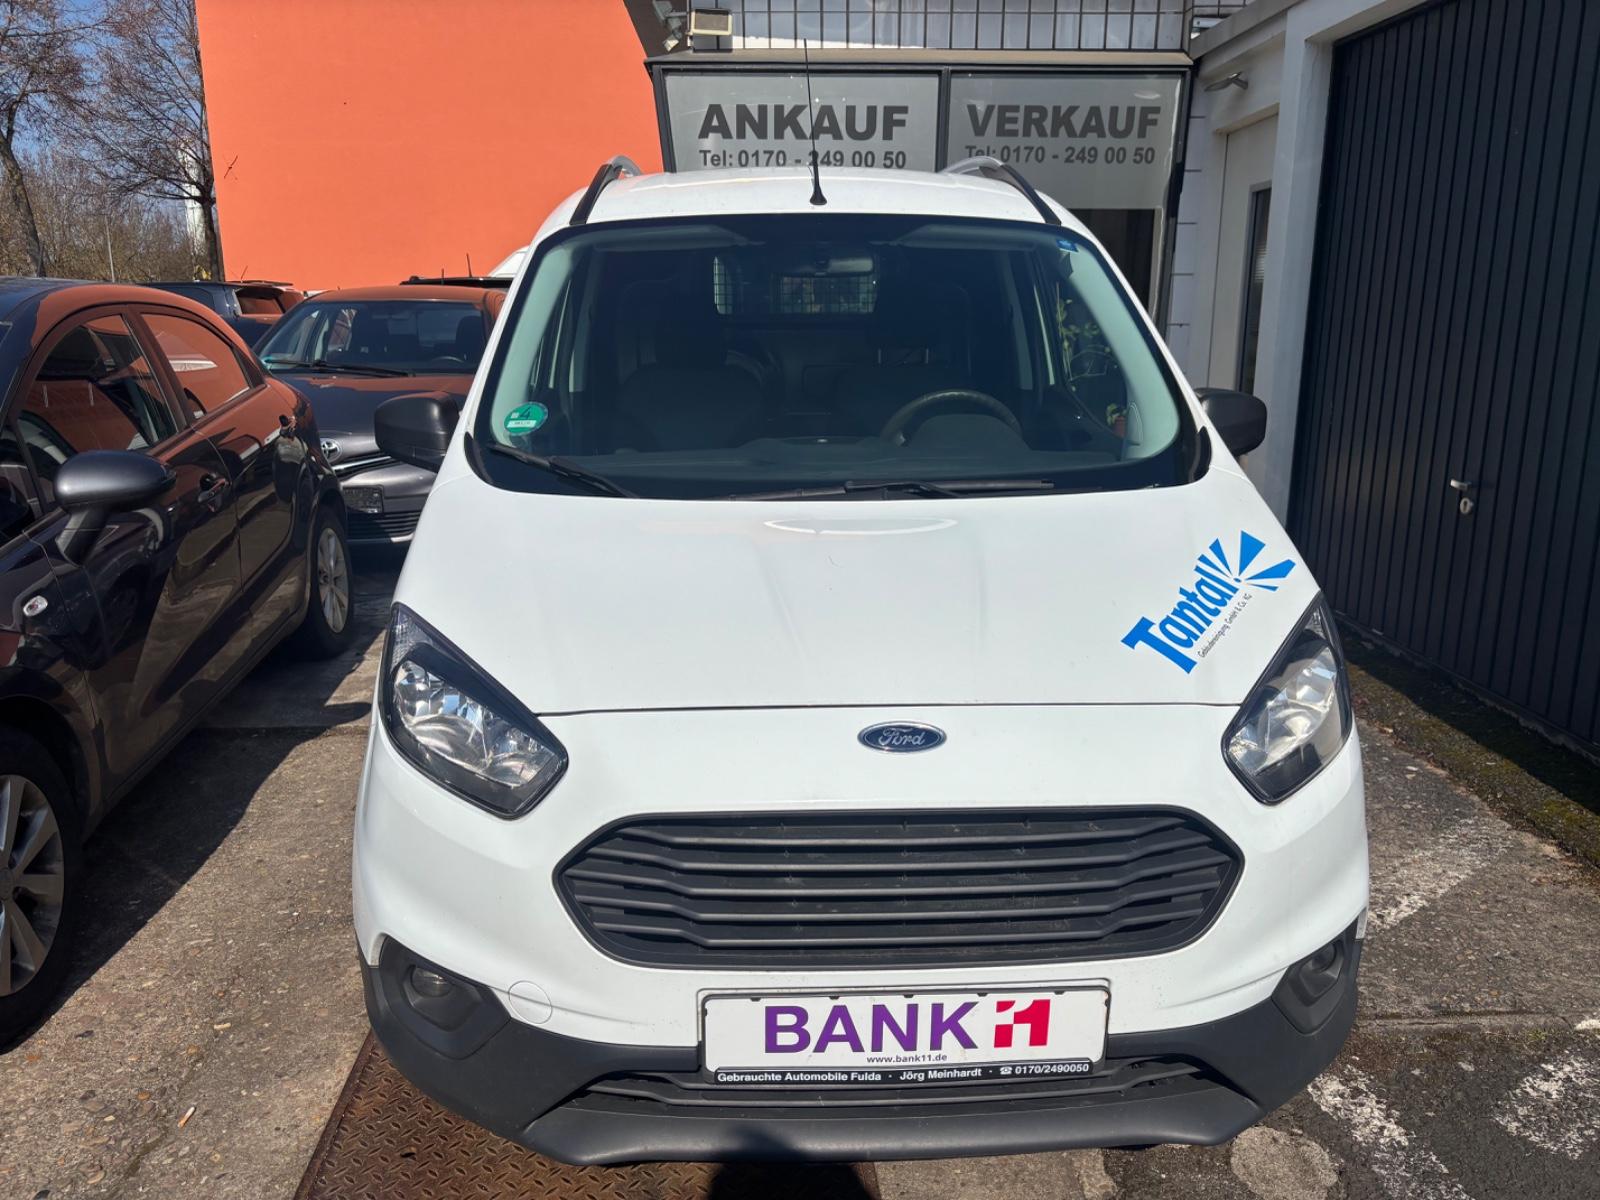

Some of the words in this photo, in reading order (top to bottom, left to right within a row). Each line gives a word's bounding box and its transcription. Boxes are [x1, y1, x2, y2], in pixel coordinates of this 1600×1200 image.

[698, 104, 908, 140] ANKAUF
[967, 104, 1161, 139] VERKAUF
[699, 150, 733, 168] Tel:
[738, 150, 787, 167] 0170
[852, 150, 875, 168] 00
[882, 151, 906, 169] 50
[1001, 146, 1045, 163] 0170
[1064, 146, 1097, 163] 249
[1104, 147, 1126, 164] 00
[1132, 147, 1155, 164] 50
[878, 727, 926, 746] Ford
[764, 1001, 979, 1053] BANK
[866, 1054, 948, 1063] www.bank11.de
[717, 1072, 782, 1082] Gebrauchte
[785, 1071, 848, 1081] Automobile
[850, 1071, 882, 1081] Fulda
[899, 1070, 925, 1081] Jörg
[928, 1068, 982, 1079] Meinhardt
[1014, 1063, 1089, 1075] 0170/2490050
